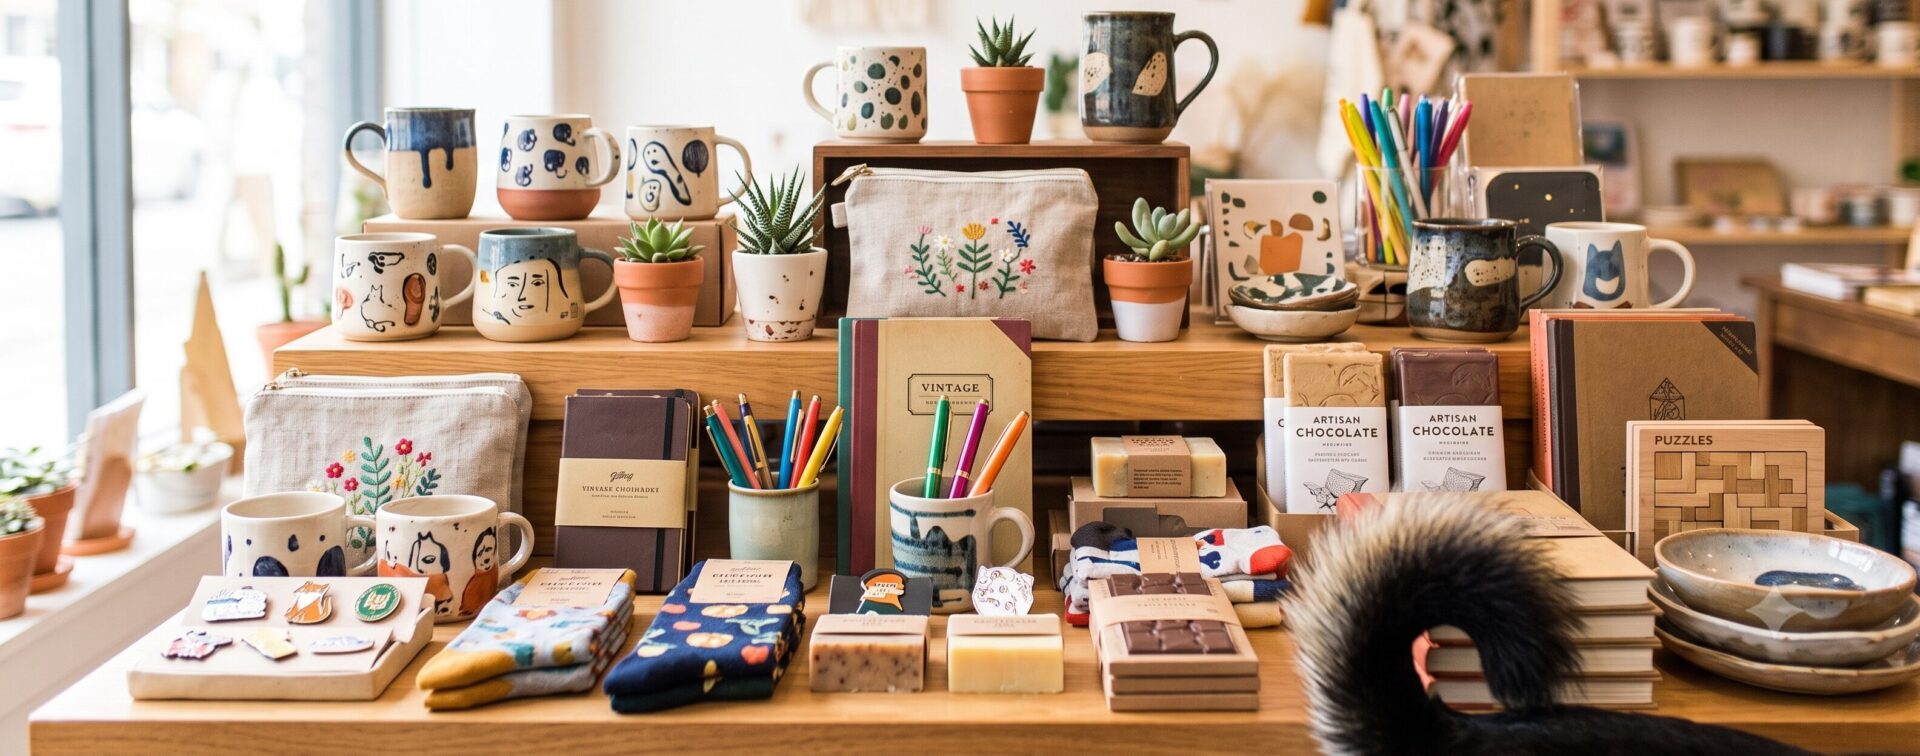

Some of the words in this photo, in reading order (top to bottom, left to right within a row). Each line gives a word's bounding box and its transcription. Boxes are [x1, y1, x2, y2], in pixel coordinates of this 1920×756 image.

[921, 383, 980, 393] VINTAGE
[1313, 415, 1361, 424] ARTISAN
[1429, 414, 1477, 423] ARTISAN
[1296, 427, 1379, 438] CHOCOLATE
[1412, 426, 1495, 437] CHOCOLATE
[1654, 435, 1713, 446] PUZZLES
